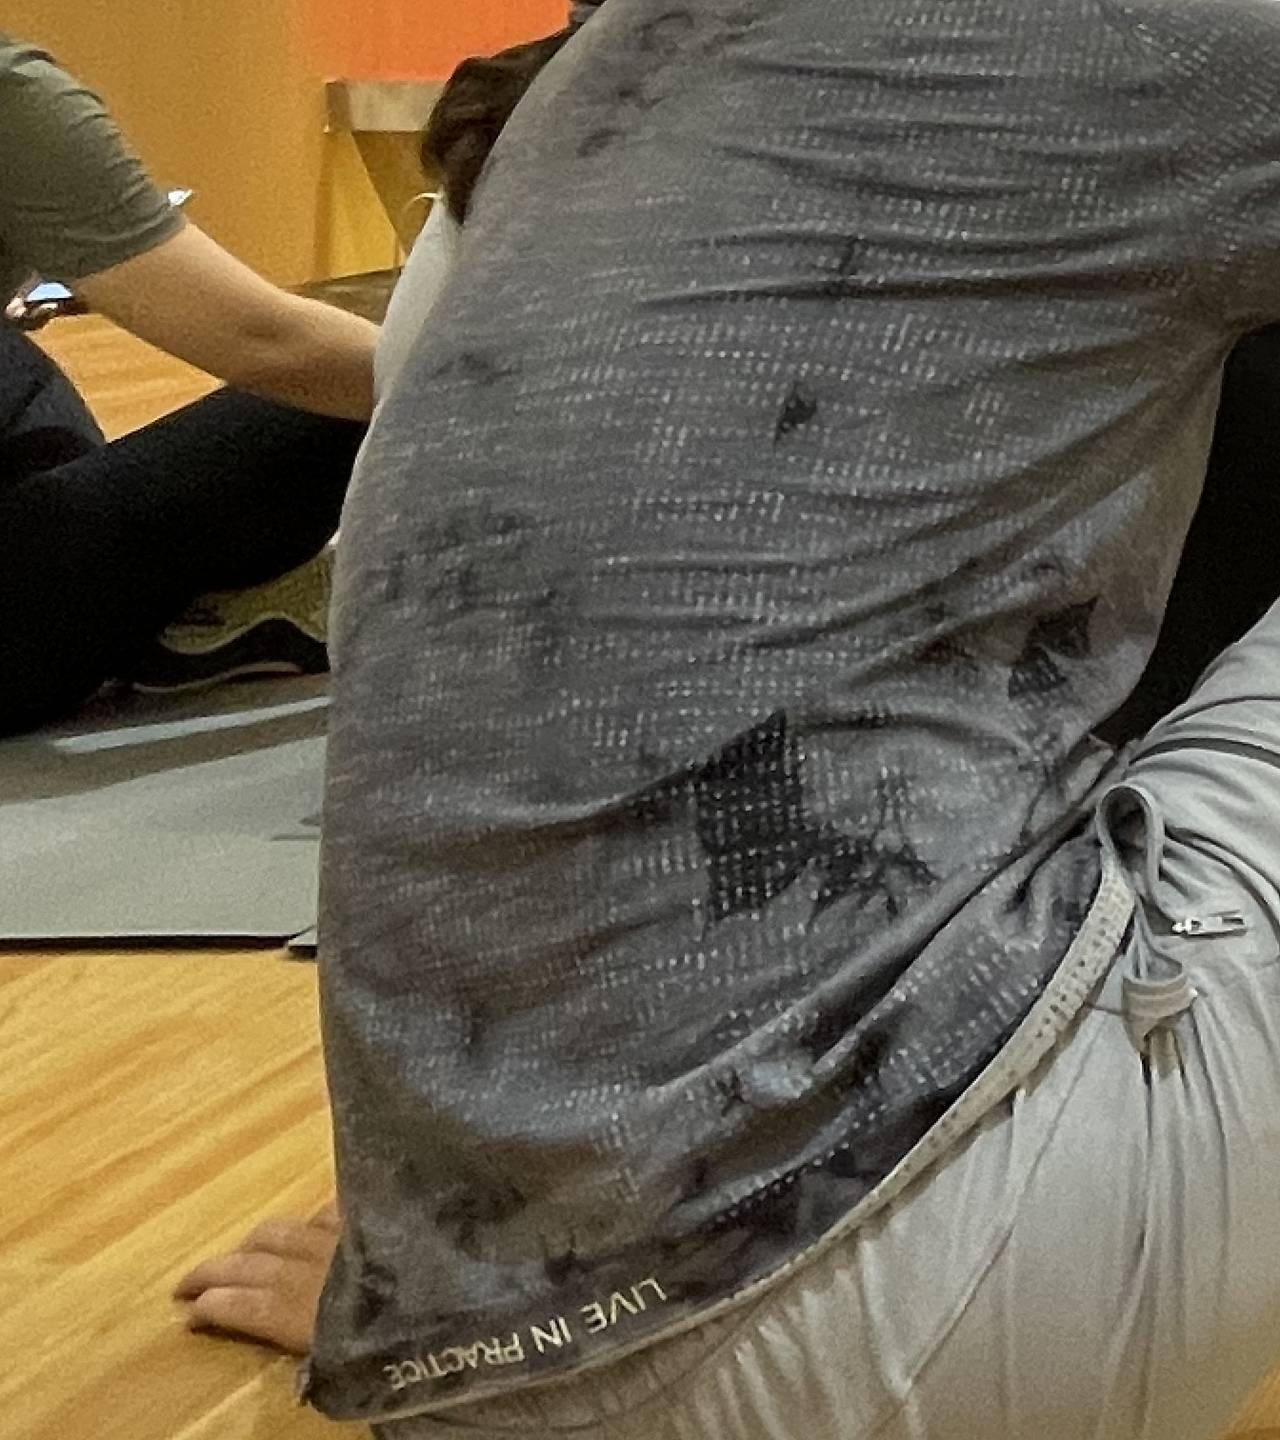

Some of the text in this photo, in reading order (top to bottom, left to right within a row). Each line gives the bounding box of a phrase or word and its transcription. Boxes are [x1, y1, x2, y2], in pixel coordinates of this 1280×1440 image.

[383, 1278, 668, 1391] LIVE IN PRACTICE
